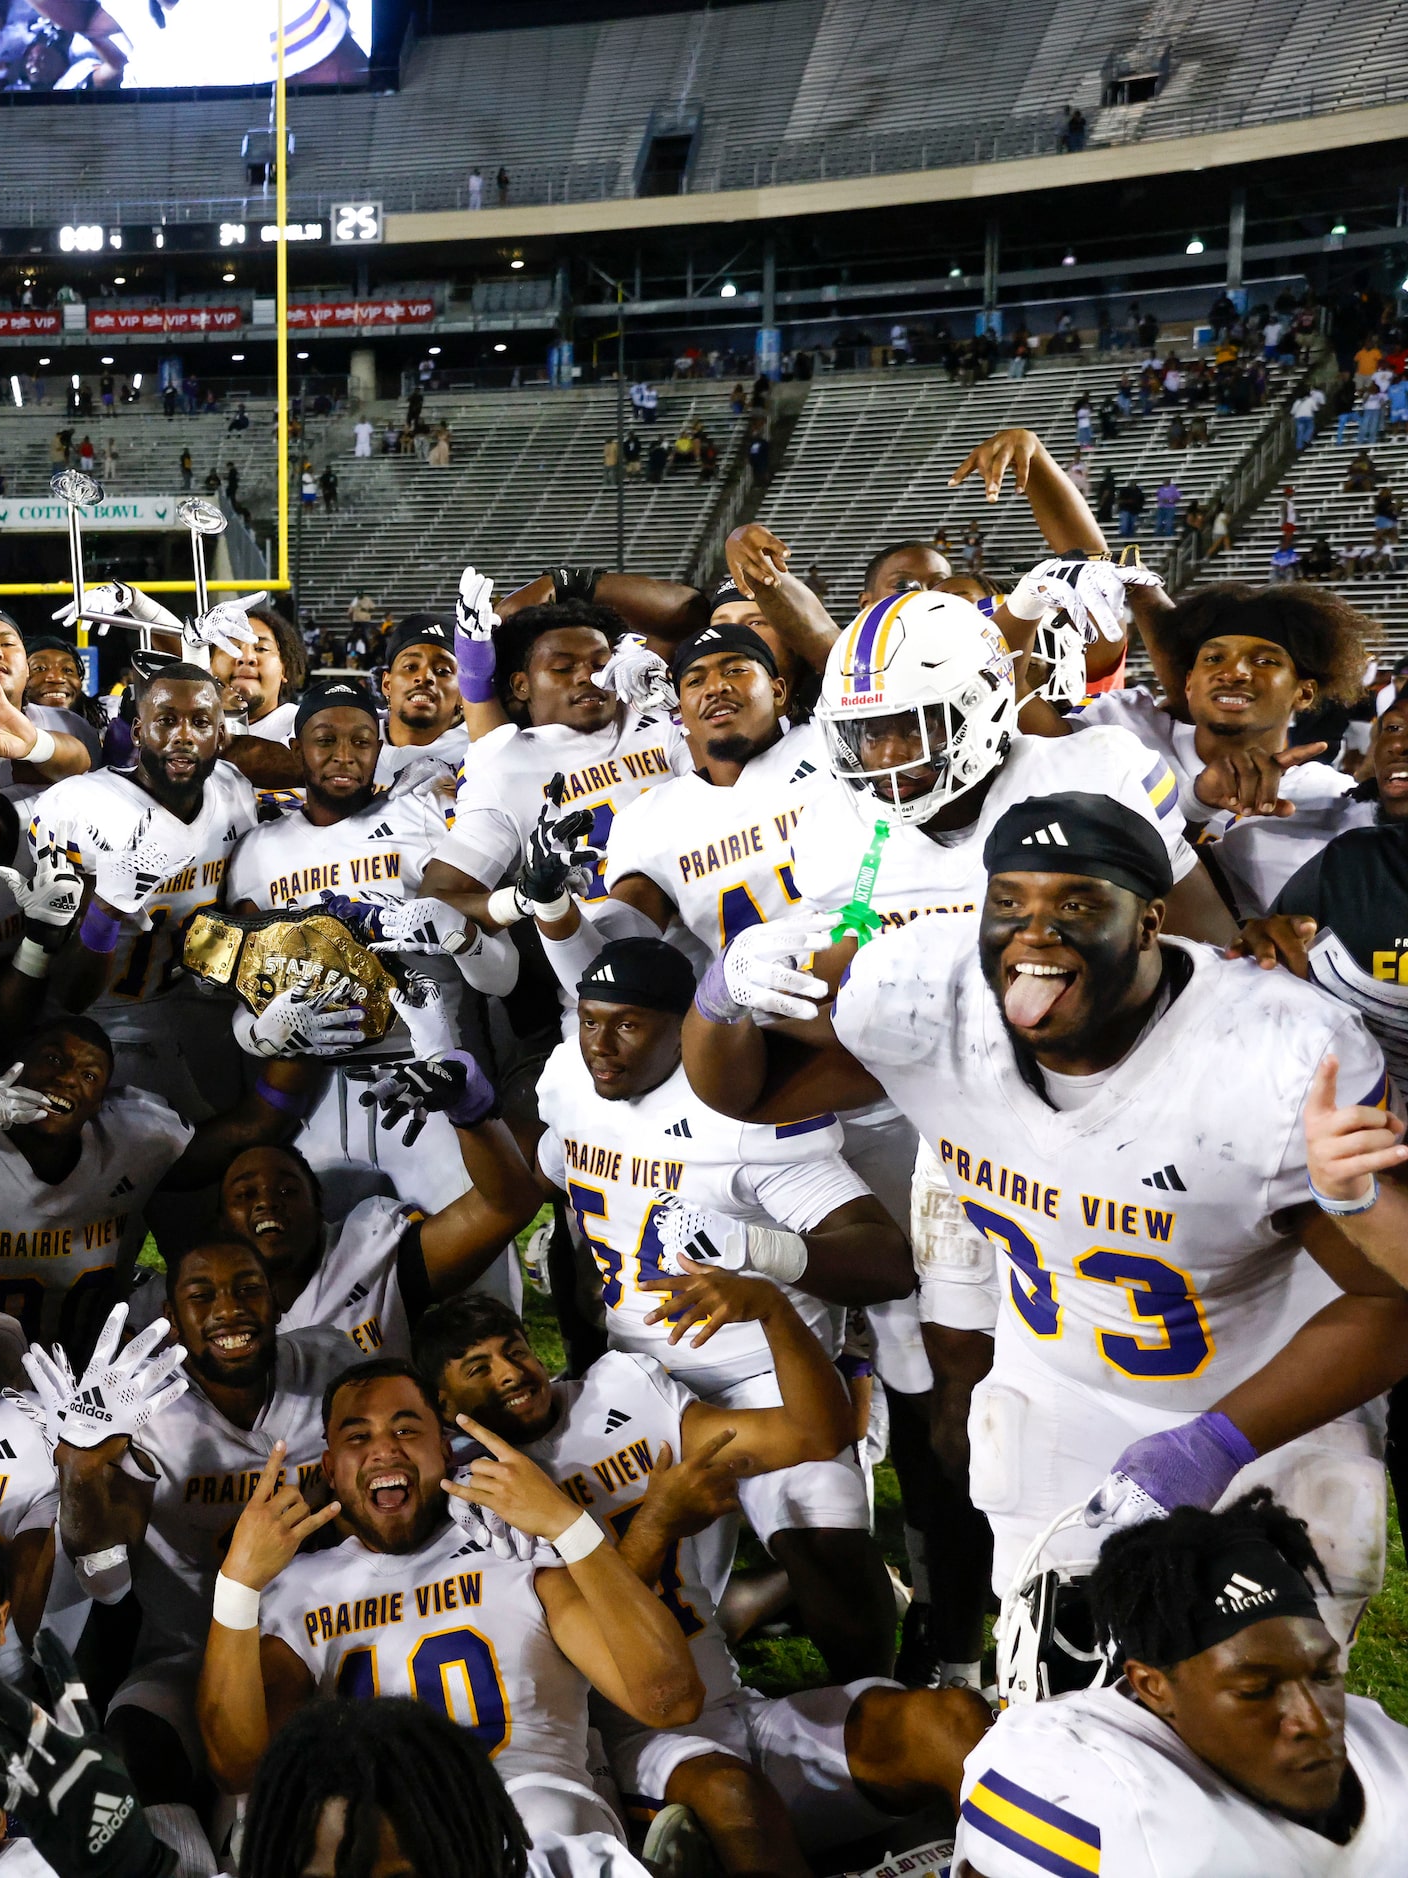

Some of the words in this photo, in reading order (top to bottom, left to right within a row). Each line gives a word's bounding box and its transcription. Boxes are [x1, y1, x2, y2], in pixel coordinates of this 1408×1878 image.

[337, 205, 377, 240] 25
[34, 317, 56, 328] VIP
[118, 316, 140, 327] VIP
[166, 315, 188, 326] VIP
[214, 313, 236, 324] VIP
[310, 309, 332, 320] VIP
[360, 307, 382, 318] VIP
[409, 304, 432, 316] VIP
[95, 504, 144, 519] BOWL
[841, 693, 883, 706] Riddell
[621, 747, 671, 780] VIEW
[678, 824, 765, 884] PRAIRIE
[269, 862, 341, 908] PRAIRIE
[350, 852, 401, 885] VIEW
[854, 866, 876, 904] NXTRND
[563, 1137, 622, 1182] PRAIRIE
[631, 1155, 684, 1191] VIEW
[938, 1137, 1060, 1221] PRAIRIE
[1081, 1192, 1177, 1245] VIEW
[83, 1212, 129, 1250] VIEW
[69, 1401, 113, 1422] adidas
[591, 1437, 657, 1495] VIEW
[304, 1591, 404, 1647] PRAIRIE
[414, 1570, 484, 1618] VIEW
[88, 1793, 135, 1855] adidas
